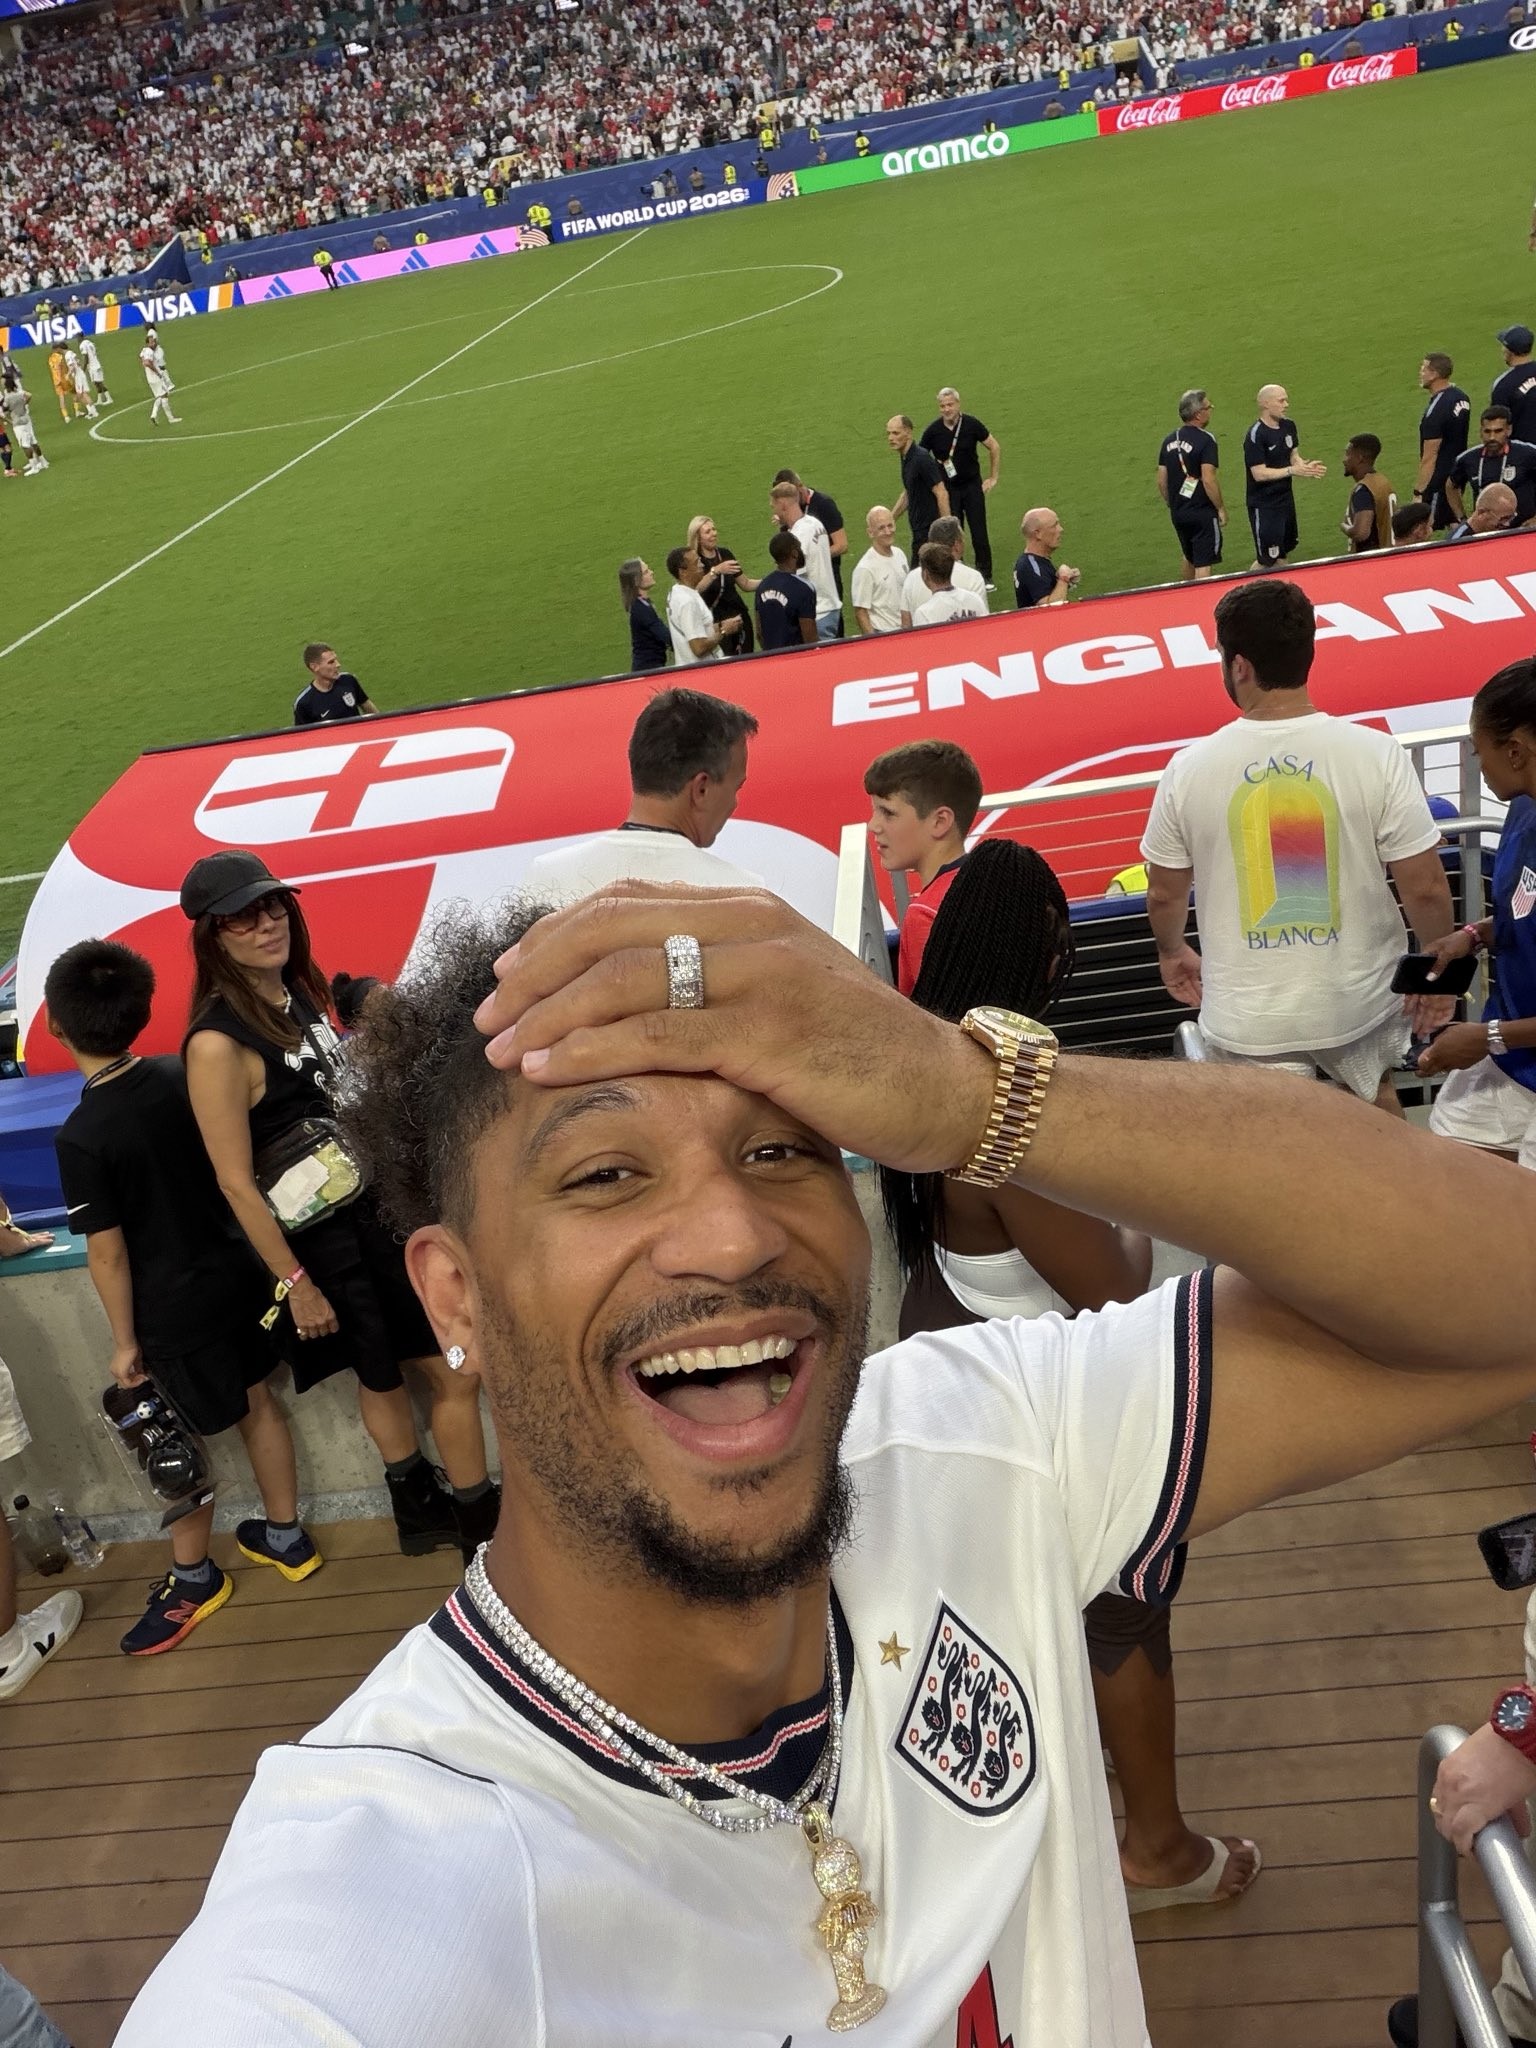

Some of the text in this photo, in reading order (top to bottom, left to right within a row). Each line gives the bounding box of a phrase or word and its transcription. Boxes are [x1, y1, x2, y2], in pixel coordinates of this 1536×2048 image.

[881, 131, 1010, 177] aramco
[561, 217, 597, 237] FIFA
[596, 206, 654, 229] WORLD
[656, 198, 688, 219] CUP
[689, 187, 745, 211] 2026
[132, 292, 197, 324] VISA
[21, 314, 84, 346] VISA
[1244, 754, 1314, 784] CASA
[1246, 926, 1340, 950] BLANCA
